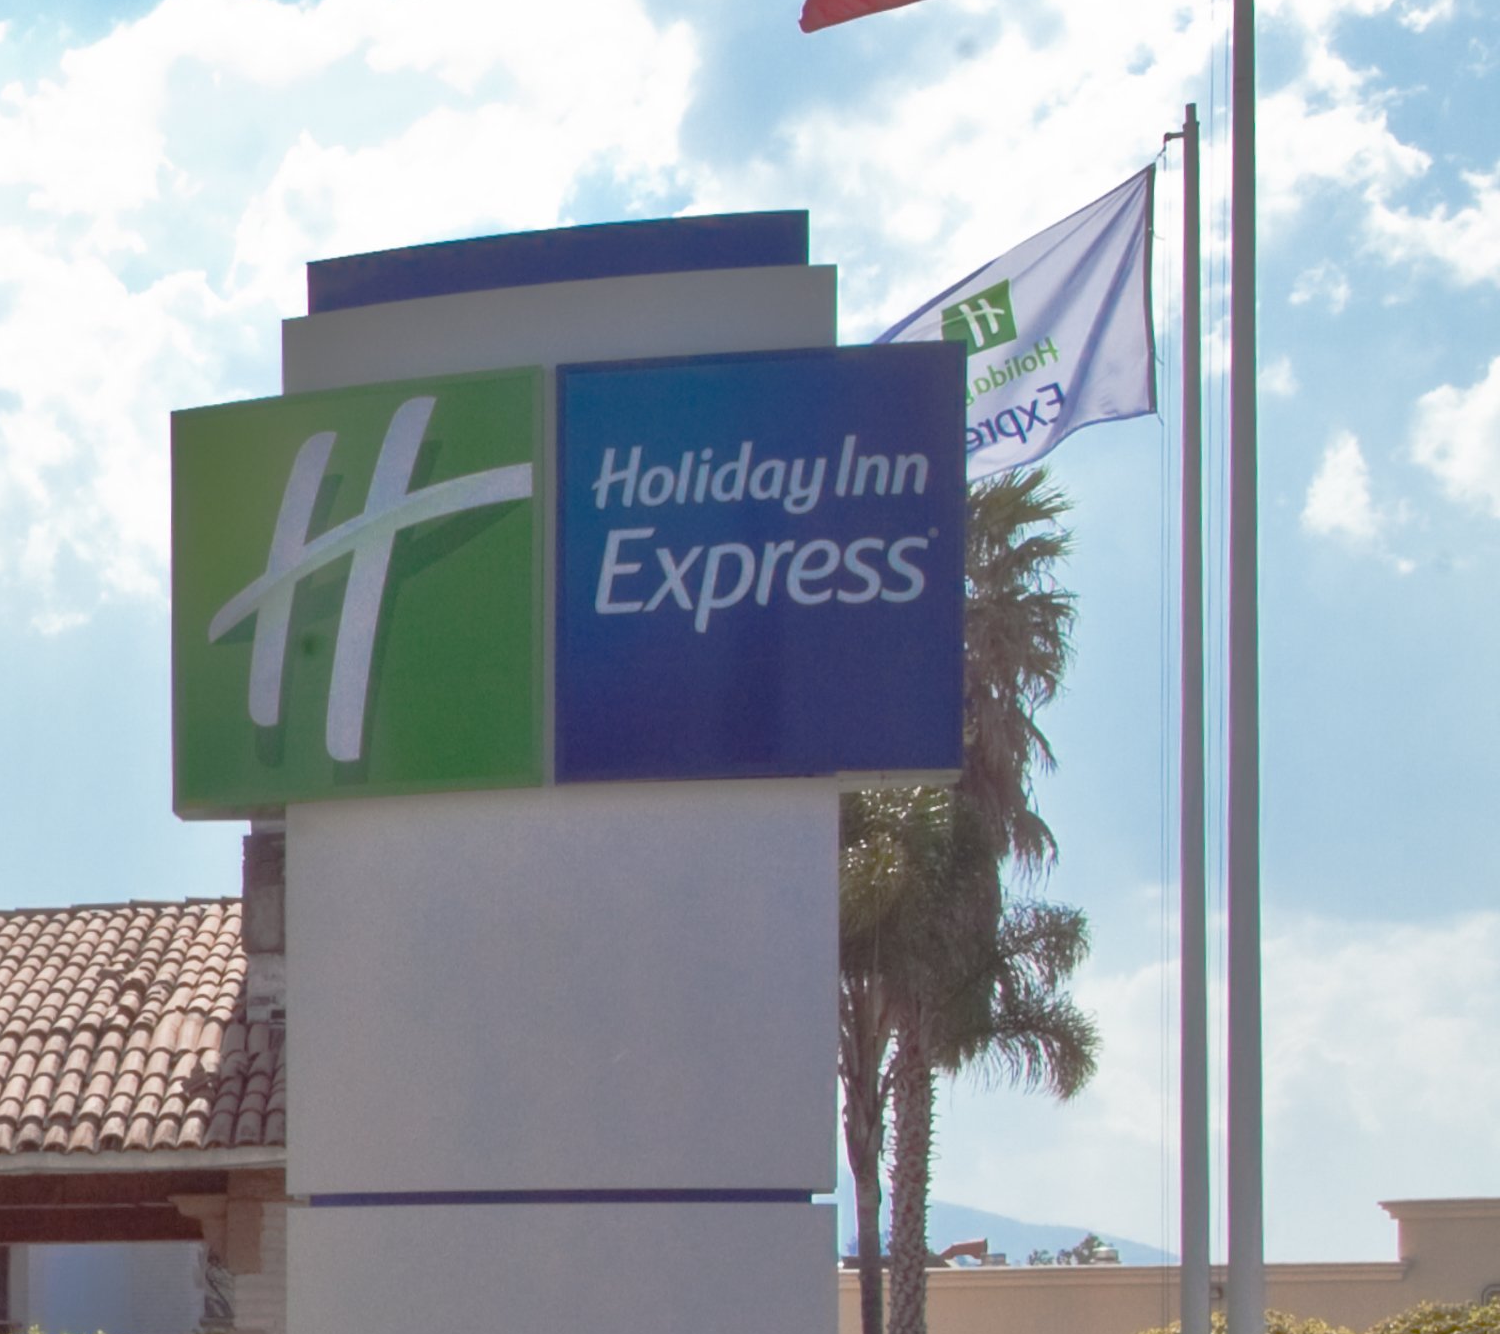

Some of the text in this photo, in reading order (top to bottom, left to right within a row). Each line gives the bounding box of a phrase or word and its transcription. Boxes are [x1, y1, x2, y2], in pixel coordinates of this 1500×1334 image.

[591, 434, 929, 515] Holiday Inn
[594, 527, 930, 633] Express
